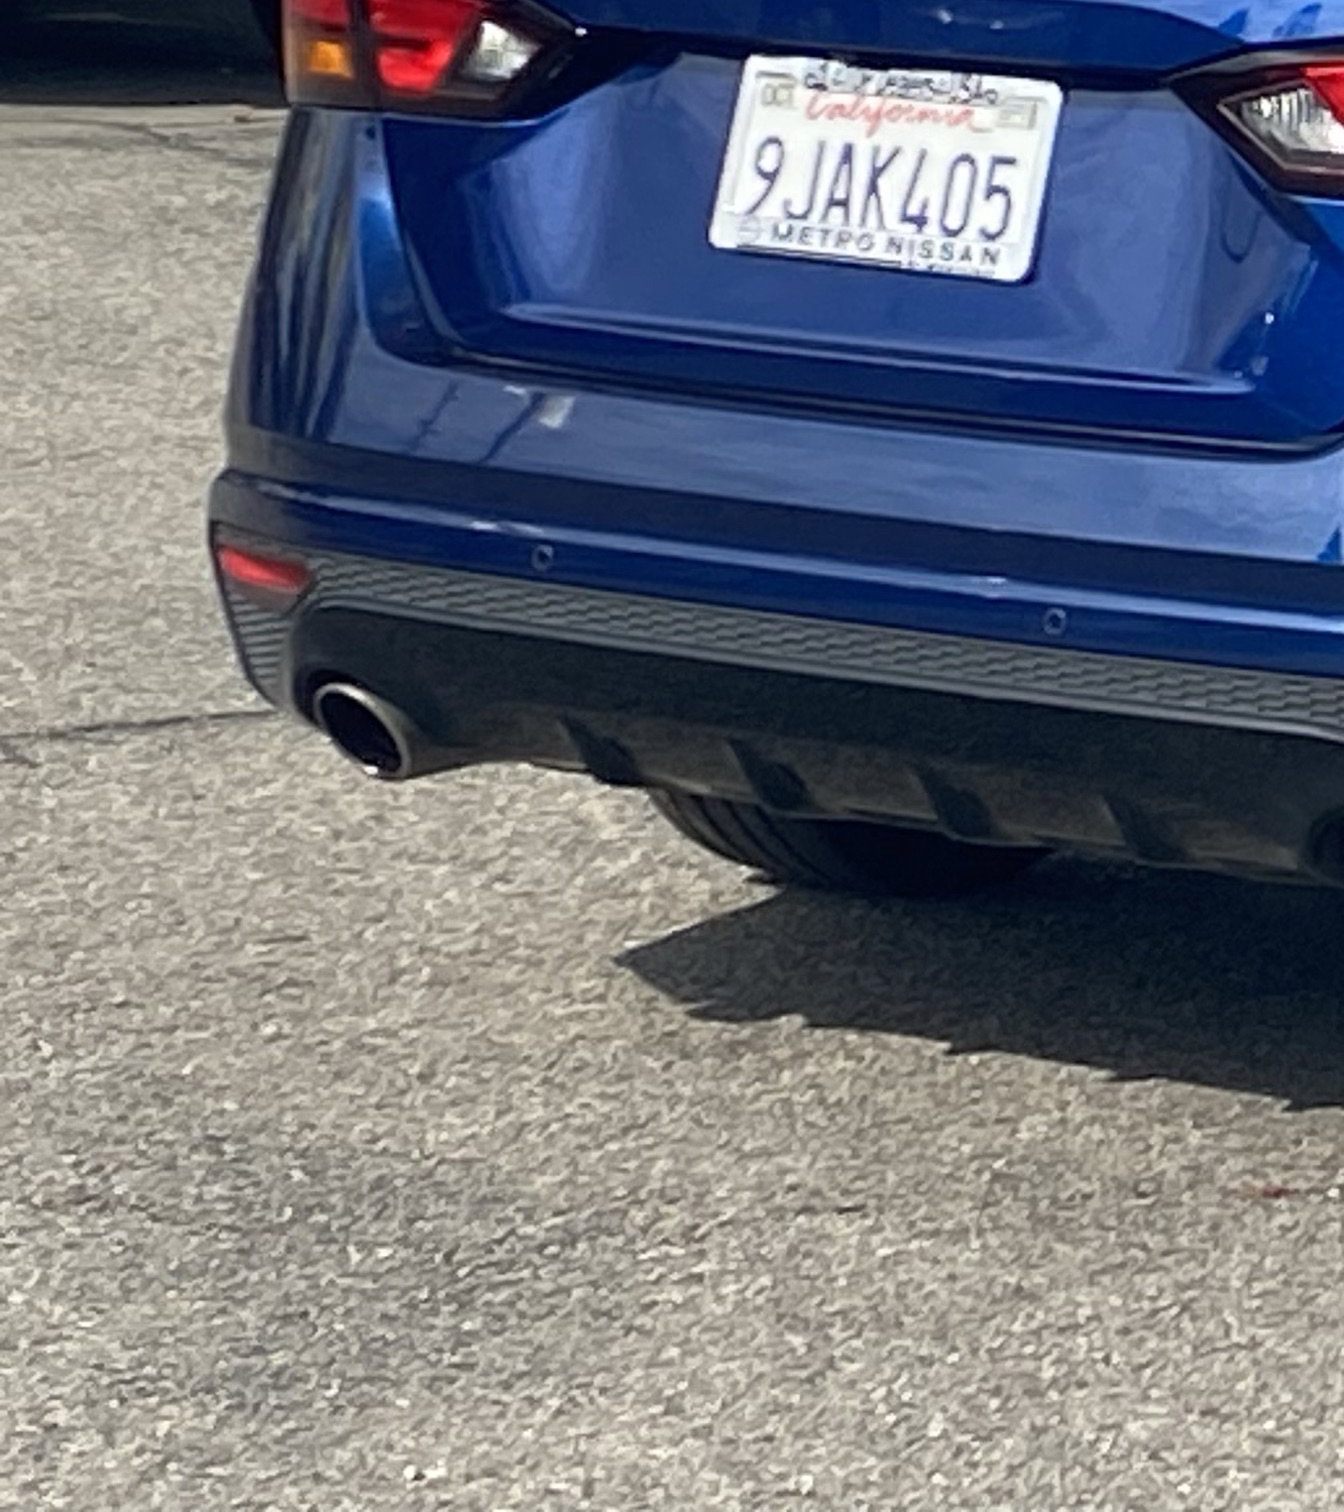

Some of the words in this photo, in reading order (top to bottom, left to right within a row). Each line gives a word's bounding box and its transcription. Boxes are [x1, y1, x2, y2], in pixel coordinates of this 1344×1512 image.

[804, 91, 994, 138] California
[744, 135, 1018, 241] 9JAK405
[771, 223, 876, 252] METRO
[884, 236, 1001, 267] NISSAN
